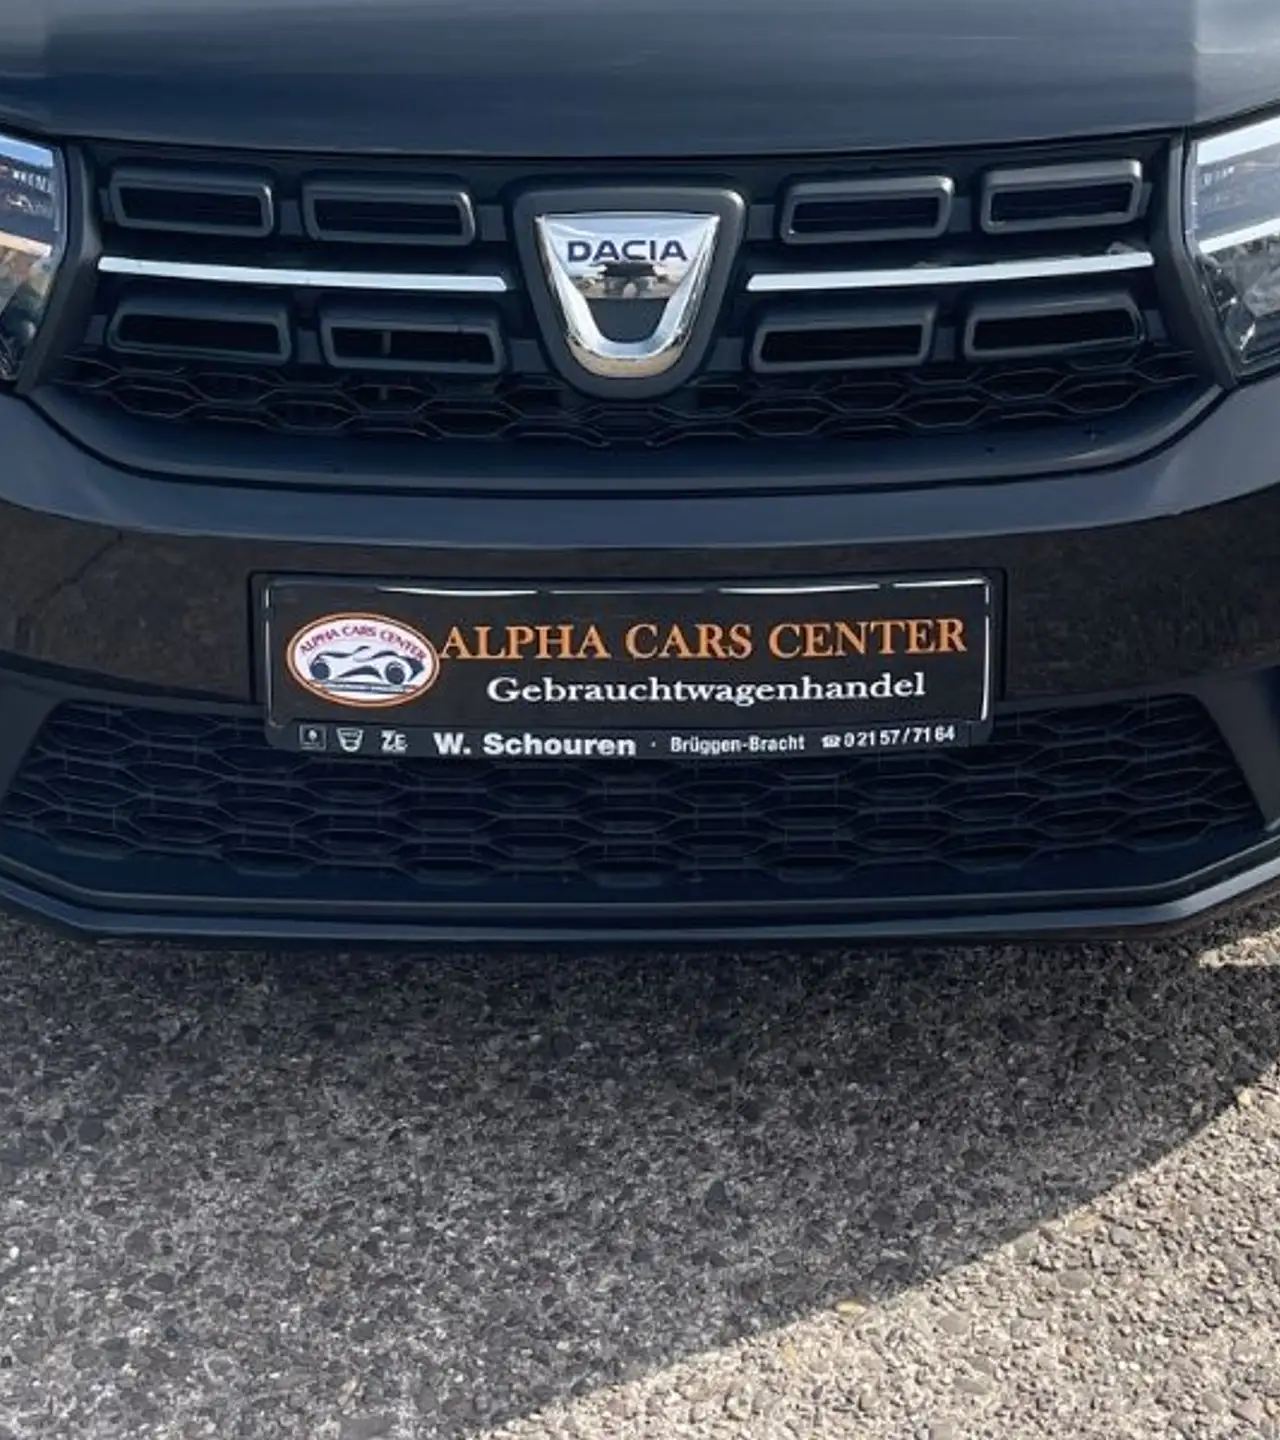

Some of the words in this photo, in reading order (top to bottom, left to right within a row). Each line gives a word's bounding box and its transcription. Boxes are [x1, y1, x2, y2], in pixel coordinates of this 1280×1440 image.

[566, 239, 688, 262] DACIA
[299, 628, 341, 655] ALPHA
[342, 624, 377, 637] CARS
[380, 630, 427, 661] CENTER
[439, 624, 612, 660] ALPHA
[624, 622, 753, 659] CARS
[769, 618, 968, 657] CENTER
[486, 671, 926, 707] Gebrauchtwagenhandel
[433, 733, 472, 756] W.
[482, 732, 637, 756] Schouren
[670, 733, 806, 755] Brüggen-Bracht
